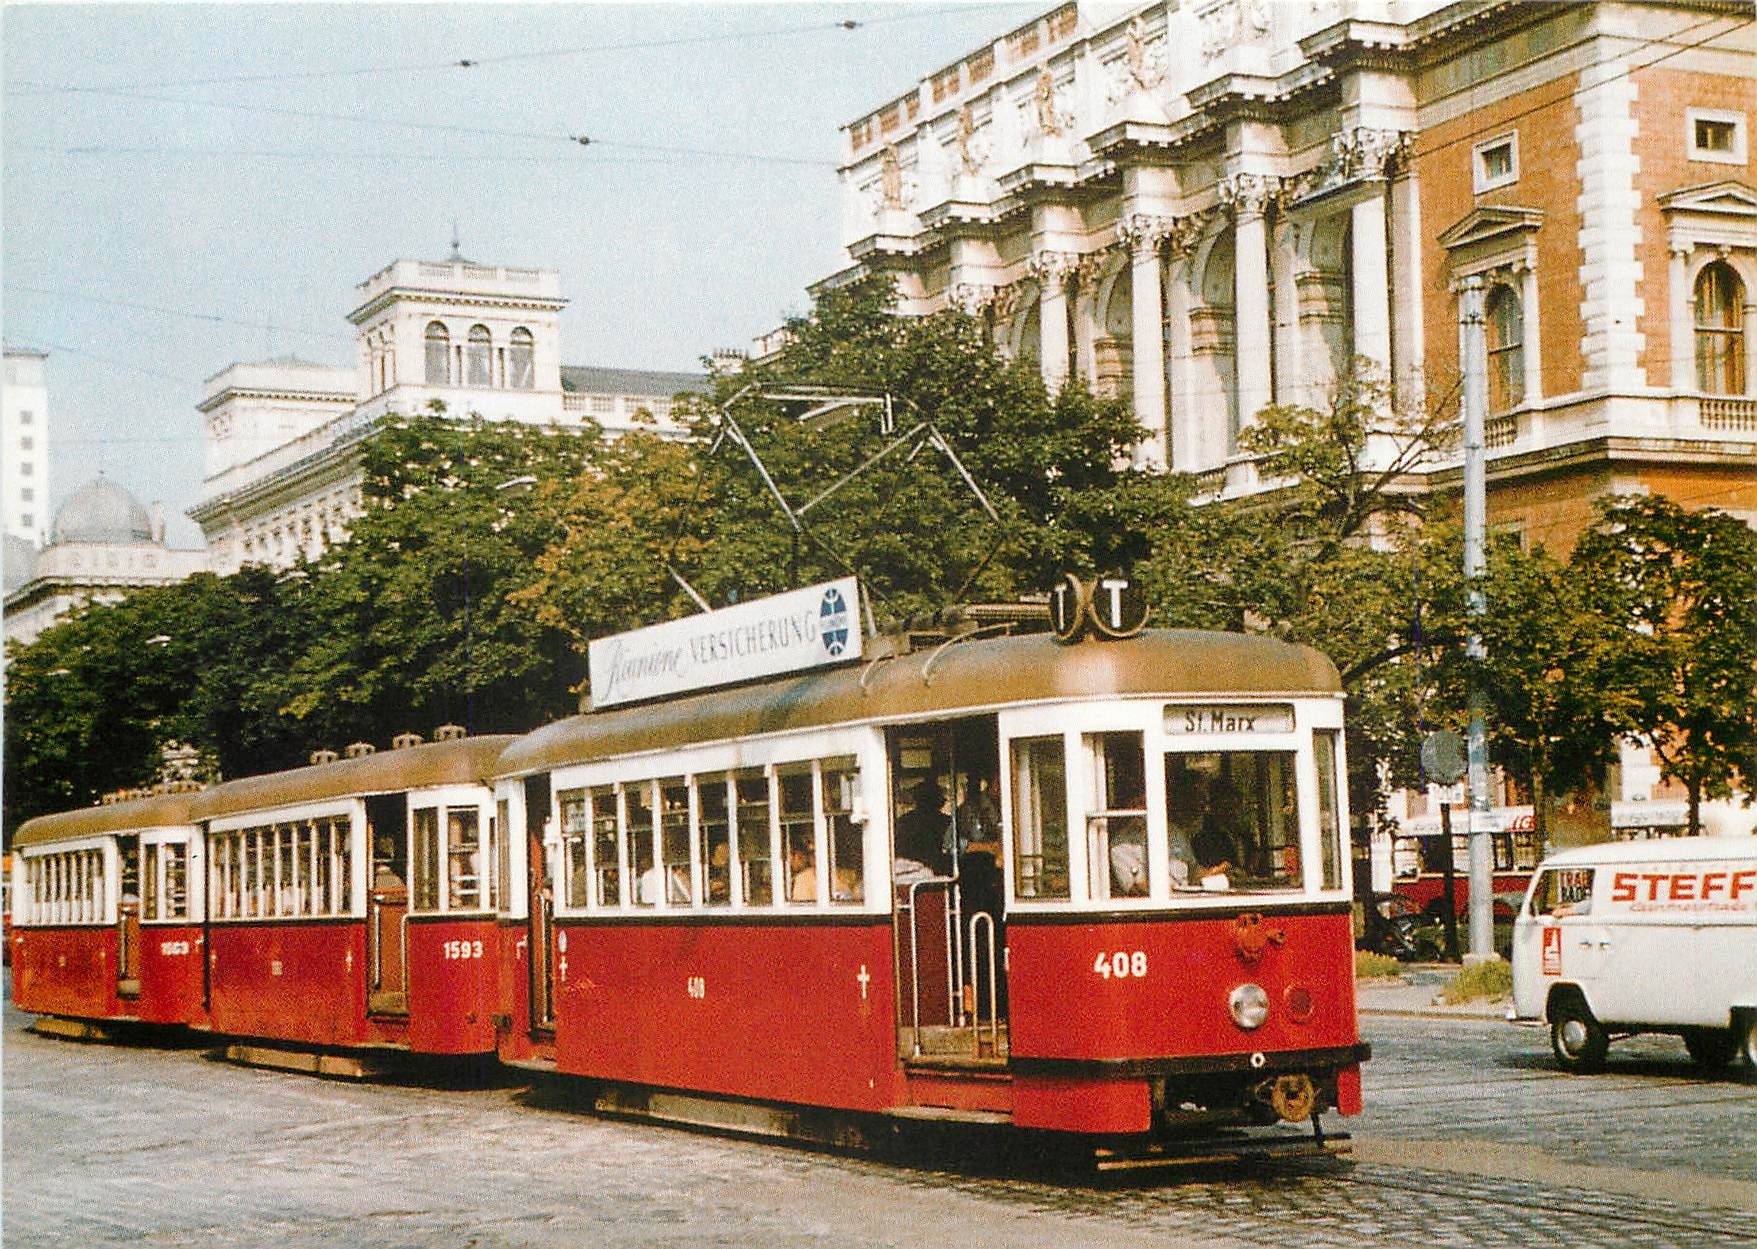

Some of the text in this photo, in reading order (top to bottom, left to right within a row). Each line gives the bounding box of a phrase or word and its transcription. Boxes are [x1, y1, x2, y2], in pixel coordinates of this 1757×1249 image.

[1102, 579, 1129, 629] T
[690, 611, 816, 664] VERSICHERUNG
[1210, 709, 1256, 733] Marx
[1611, 870, 1757, 902] STEFF
[443, 940, 484, 961] 1593
[1093, 950, 1148, 980] 408
